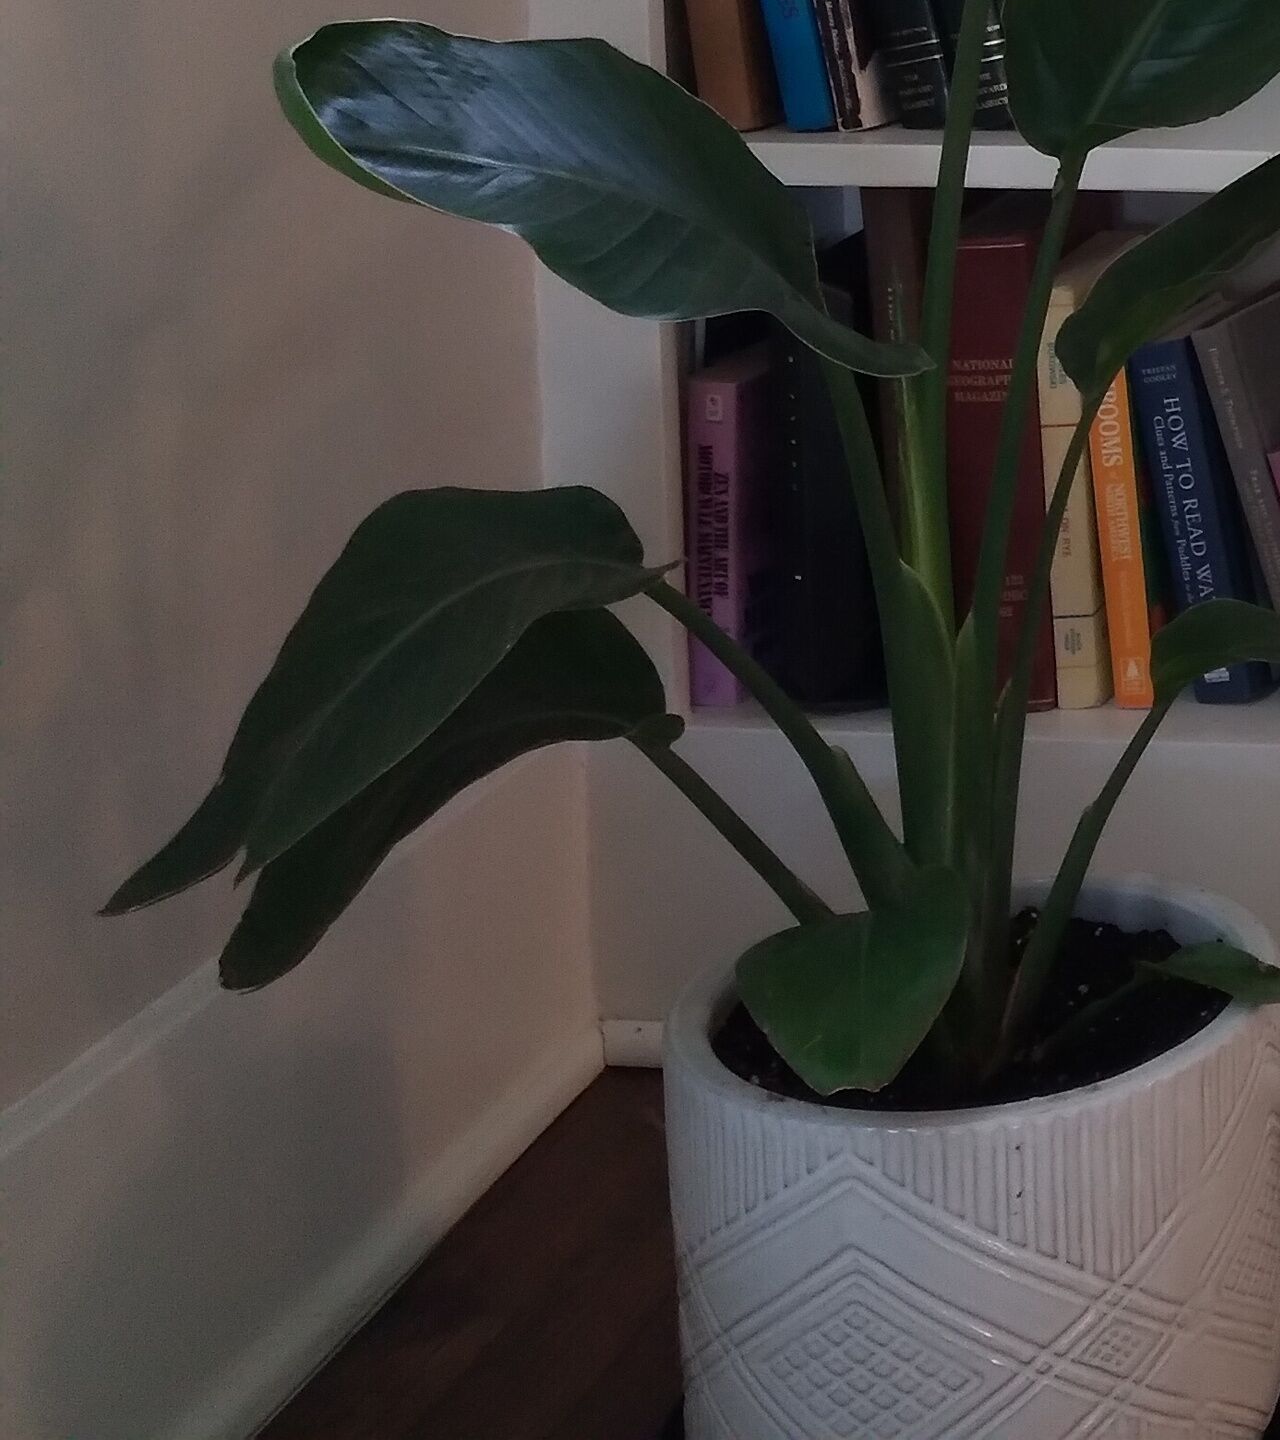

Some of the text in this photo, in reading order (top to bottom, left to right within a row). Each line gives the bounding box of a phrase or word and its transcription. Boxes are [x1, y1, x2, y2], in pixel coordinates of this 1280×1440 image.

[1151, 415, 1168, 446] Clues
[1164, 397, 1189, 452] HOW
[1158, 450, 1172, 469] and
[1174, 458, 1195, 491] TO
[1162, 473, 1180, 516] Patterns
[1183, 498, 1207, 558] READ
[1175, 539, 1192, 581] Puddles
